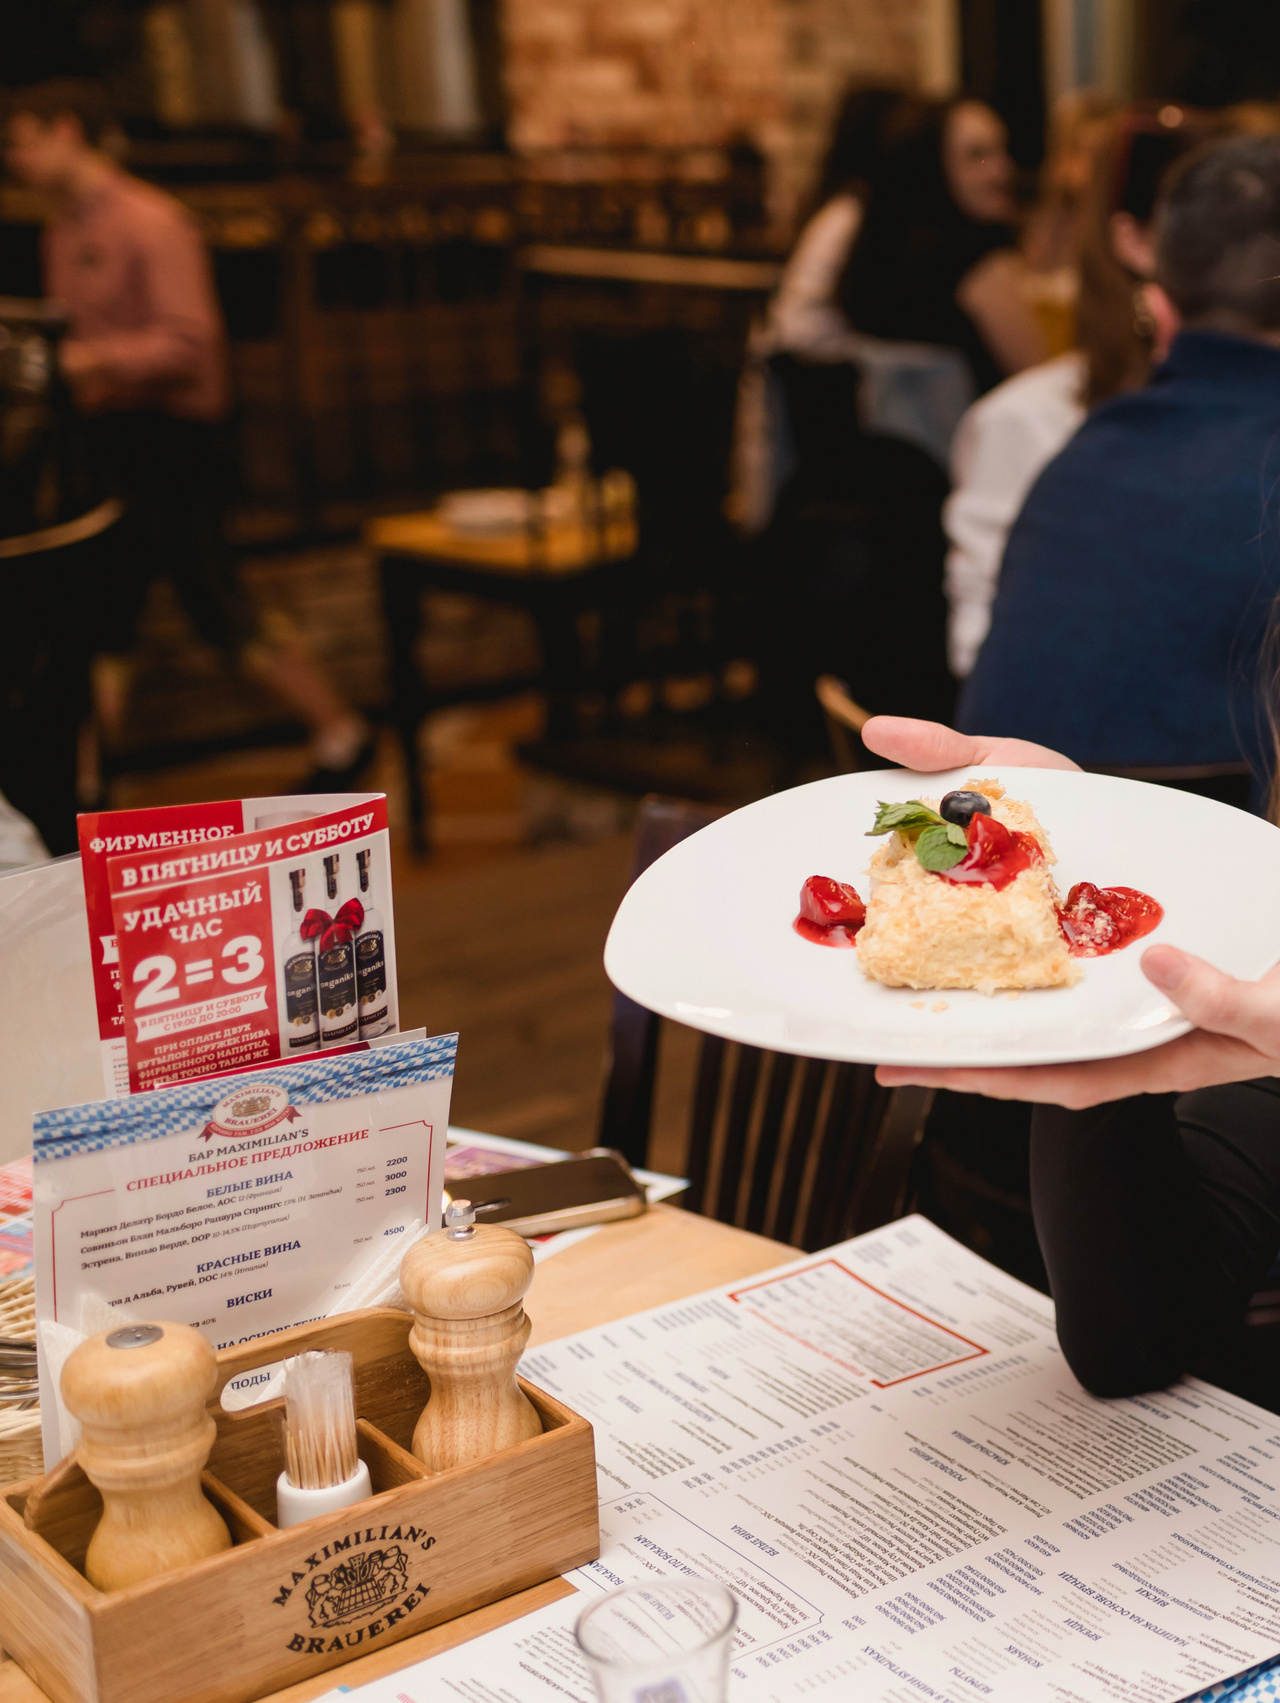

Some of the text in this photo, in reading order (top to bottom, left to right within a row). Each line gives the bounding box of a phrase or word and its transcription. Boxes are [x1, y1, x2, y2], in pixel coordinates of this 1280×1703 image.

[89, 825, 235, 853] ФИРМЕННОЕ
[122, 812, 374, 887] В ПЯТНИЦУ И СУББОТУ
[123, 881, 262, 931] УДАЧНЫЙ
[170, 919, 223, 944] ЧАС
[140, 991, 262, 1028] В ПЯТНИЦУ И СУББОТУ
[172, 1017, 196, 1029] 19:00
[198, 1012, 214, 1023] ДО
[216, 1005, 241, 1017] 20:00
[137, 1049, 189, 1069] БУТЫЛОК
[196, 1036, 240, 1054] КРУЖЕК
[241, 1028, 270, 1042] ПИВА
[154, 1023, 251, 1055] ПРИ ОПЛАТЕ ДВУХ
[138, 1052, 215, 1079] ФИРМЕННОГО
[216, 1038, 270, 1059] НАПИТКА,
[139, 1048, 269, 1089] ТРЕТЬЯ ТОЧНО ТАКАЯ ЖЕ
[223, 1106, 279, 1128] BRAUEREI
[126, 1129, 369, 1192] СПЕЦИАЛЬНОЕ ПРЕДЛОЖЕНИЕ
[188, 1129, 309, 1163] БАР MAXIMILIAN'S
[80, 1225, 117, 1239] Маркиз
[119, 1215, 154, 1231] Делатр
[155, 1208, 183, 1222] Бордо
[186, 1200, 215, 1215] Белое,
[386, 1155, 407, 1167] 2200
[206, 1168, 292, 1199] БЕЛЫЕ ВИНА
[80, 1236, 128, 1256] Совиньон
[130, 1230, 153, 1243] Блан
[155, 1218, 202, 1237] Мальборо
[204, 1209, 241, 1226] Рапаура
[243, 1199, 281, 1216] Спрингс
[385, 1170, 406, 1182] 3000
[125, 1244, 158, 1259] Винью
[159, 1237, 188, 1252] Верде,
[191, 1232, 210, 1243] DOP
[384, 1184, 406, 1196] 2300
[132, 1285, 164, 1301] Альба,
[166, 1277, 196, 1294] Рувей,
[198, 1272, 218, 1284] DOC
[383, 1225, 404, 1237] 4500
[196, 1238, 301, 1274] КРАСНЫЕ ВИНА
[226, 1288, 272, 1308] ВИСКИ
[201, 1316, 216, 1326] 40%
[632, 1532, 674, 1561] БОКАЛАМ
[728, 1523, 780, 1557] БЕЛЫЕ ВИНА
[273, 1524, 437, 1607] MAXIMILIAN'S
[1056, 1569, 1190, 1648] НАПИТОК НА ОСНОВЕ БРЕНДИ
[1133, 1586, 1170, 1608] ВИСКИ
[286, 1582, 432, 1655] BRAUEREI
[839, 1618, 859, 1631] 1200
[1062, 1616, 1103, 1641] БРЕНДИ
[858, 1644, 912, 1680] БУТЫЛКАХ
[1002, 1643, 1044, 1669] КОНЬЯК
[947, 1665, 994, 1695] ВЕРМУТЫ
